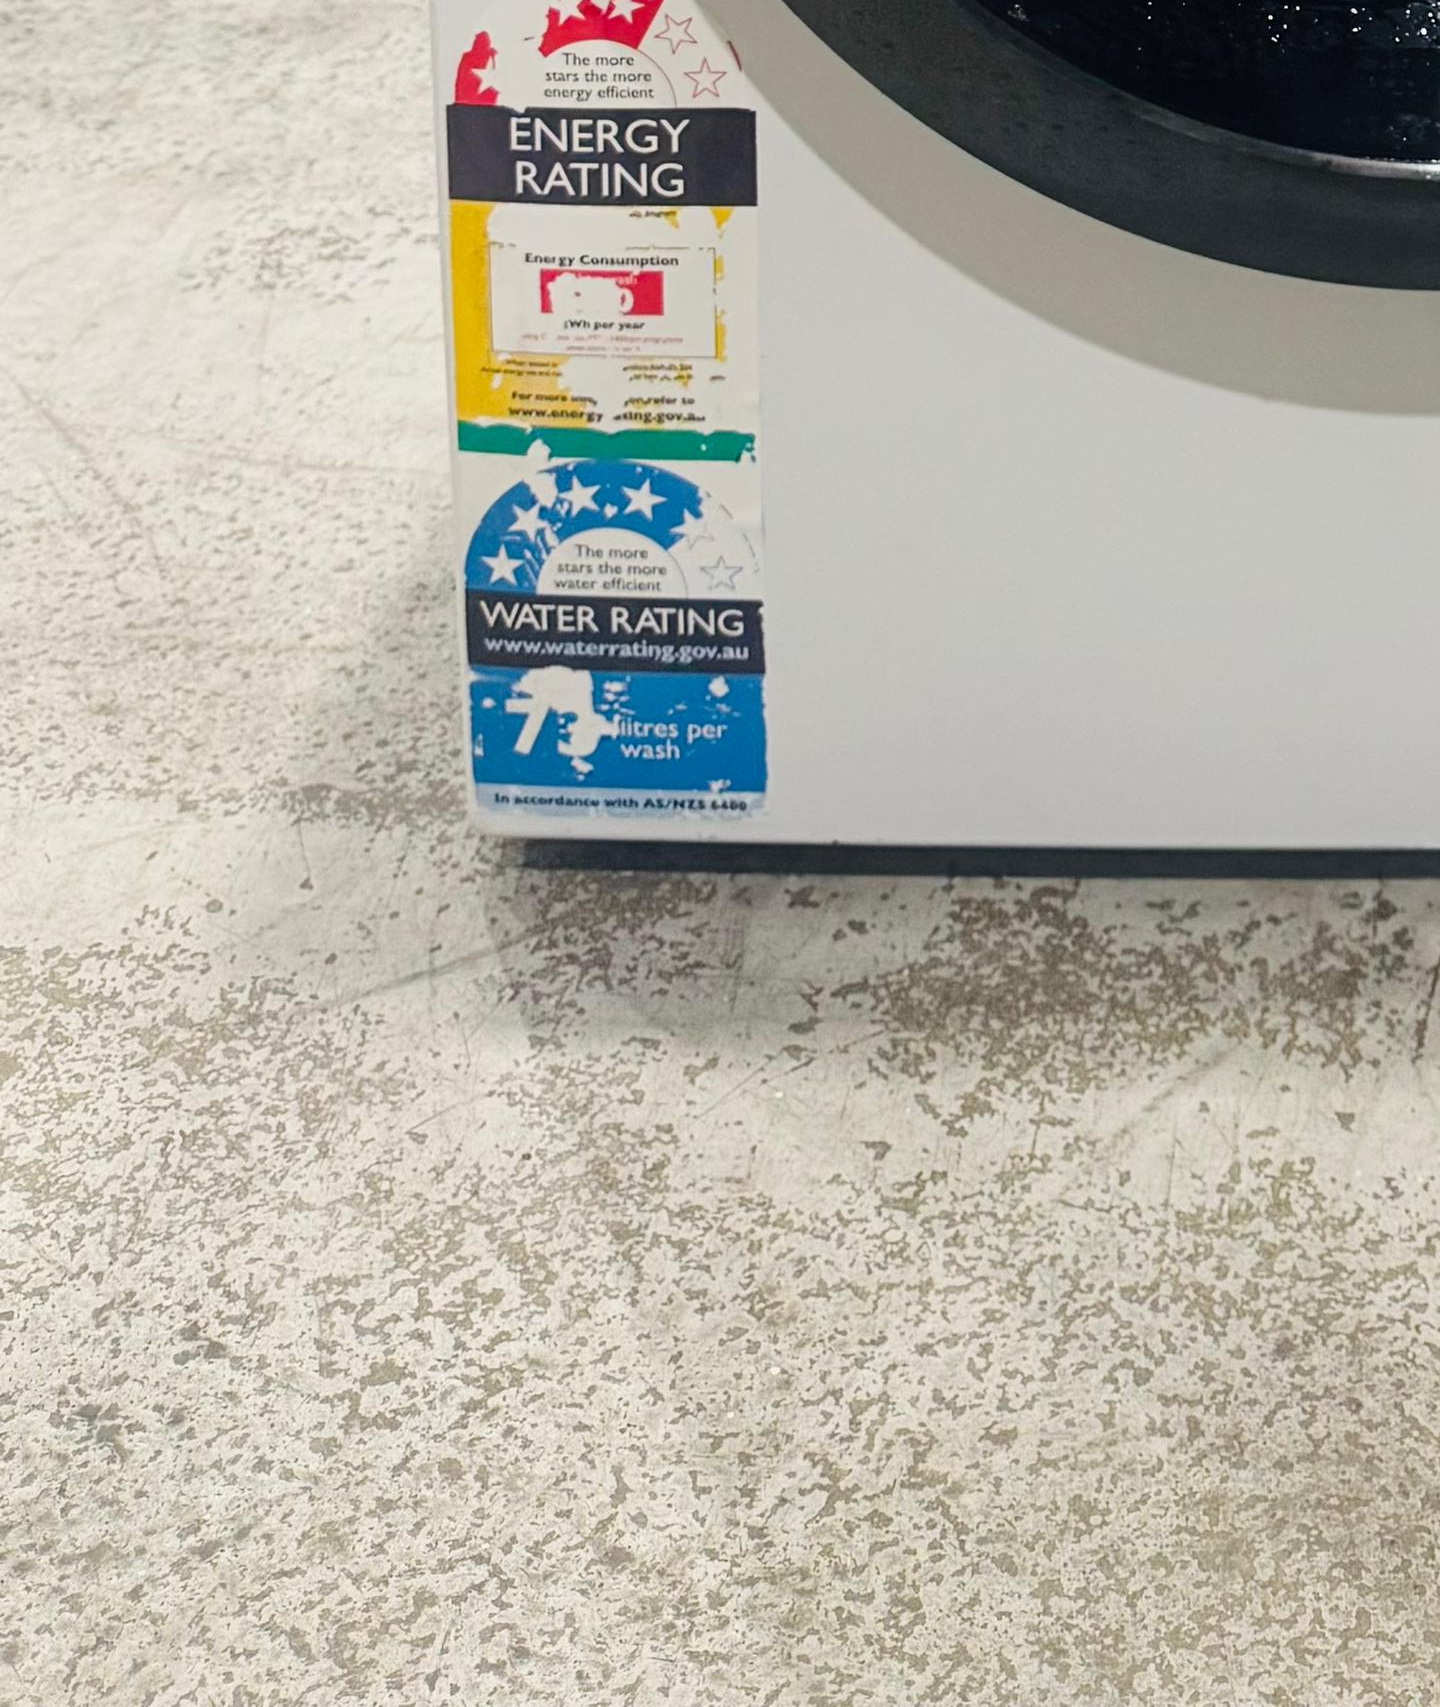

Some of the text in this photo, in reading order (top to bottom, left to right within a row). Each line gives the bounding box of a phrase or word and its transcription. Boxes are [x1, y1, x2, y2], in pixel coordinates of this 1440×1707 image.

[562, 53, 634, 66] The more
[545, 69, 652, 82] stars the more
[544, 86, 654, 102] energy efficient
[510, 117, 690, 154] ENERGY
[515, 162, 684, 197] RATING
[525, 252, 679, 268] Energy Consumption
[593, 320, 615, 330] per
[618, 321, 645, 331] year
[575, 544, 648, 559] The more
[557, 561, 667, 575] stars the more
[554, 578, 662, 592] water efficient
[480, 600, 744, 636] WATER RATING
[484, 638, 749, 664] www.waterrating.gov.au
[687, 720, 728, 744] per
[620, 741, 681, 760] wash
[494, 793, 510, 804] In
[514, 794, 600, 807] accordance
[604, 797, 638, 809] with
